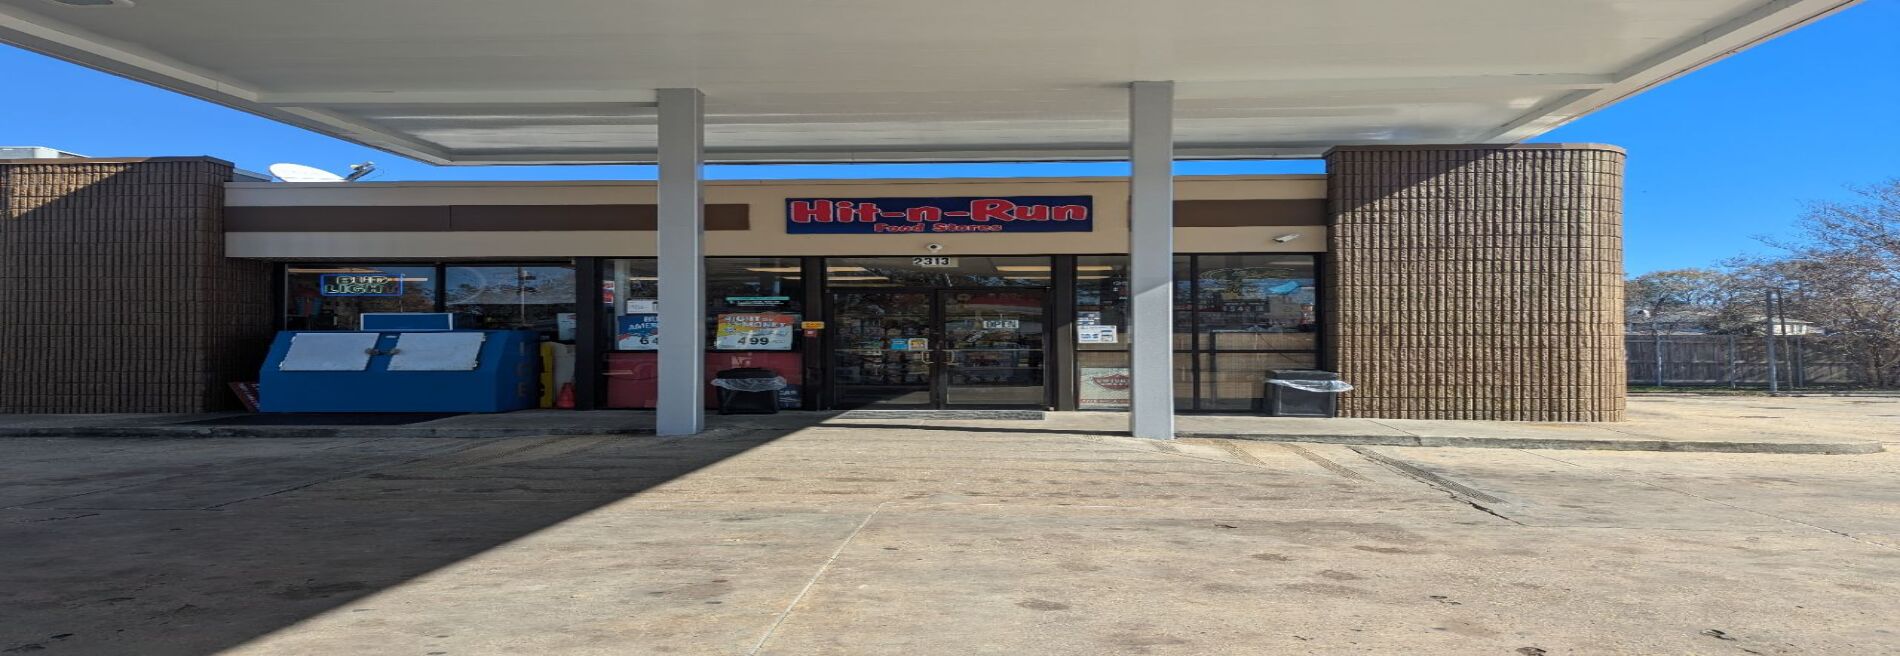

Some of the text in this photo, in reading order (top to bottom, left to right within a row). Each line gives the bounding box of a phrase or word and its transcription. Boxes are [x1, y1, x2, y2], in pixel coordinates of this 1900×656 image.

[790, 199, 1088, 223] Hit-n-Run
[873, 223, 1004, 233] Food Stores
[913, 257, 949, 265] 2313
